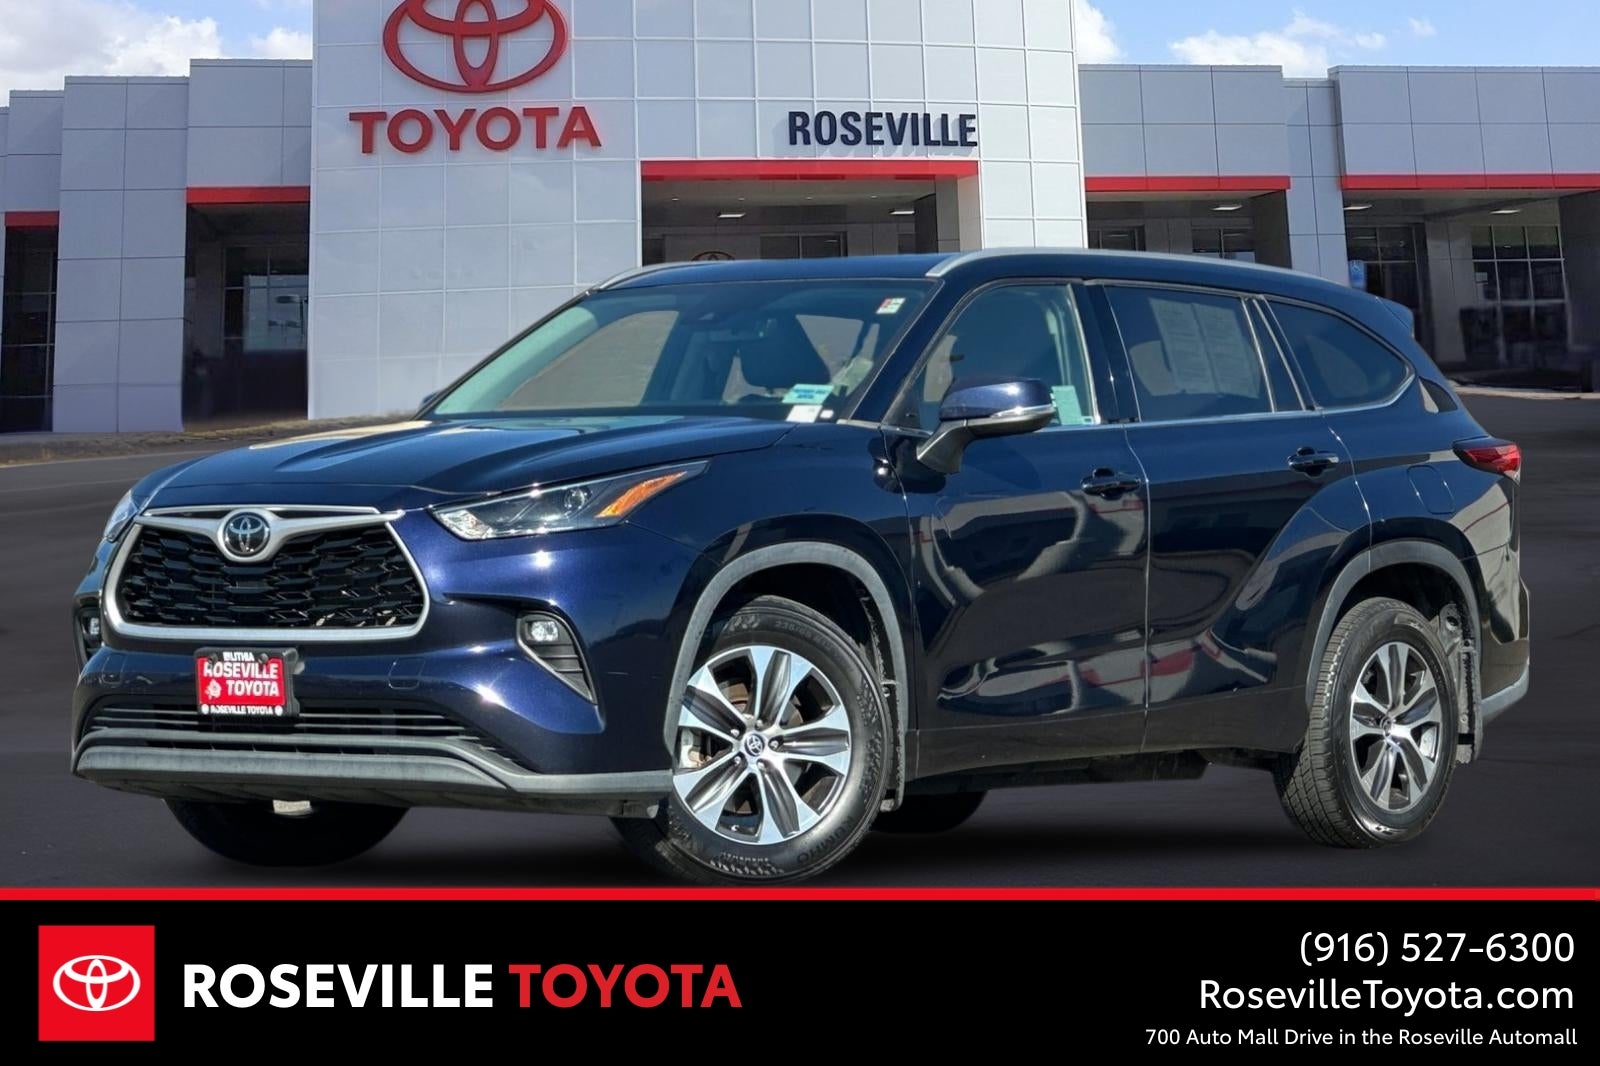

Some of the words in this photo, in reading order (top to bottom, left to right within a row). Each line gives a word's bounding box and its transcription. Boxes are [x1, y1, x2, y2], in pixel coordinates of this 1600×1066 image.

[349, 106, 602, 154] TOYOTA
[788, 111, 978, 147] ROSEVILLE
[203, 661, 278, 679] ROSEVILLE
[226, 680, 279, 696] TOYOTA
[210, 705, 246, 714] ROSEVILLE
[247, 706, 273, 714] TOYOTA
